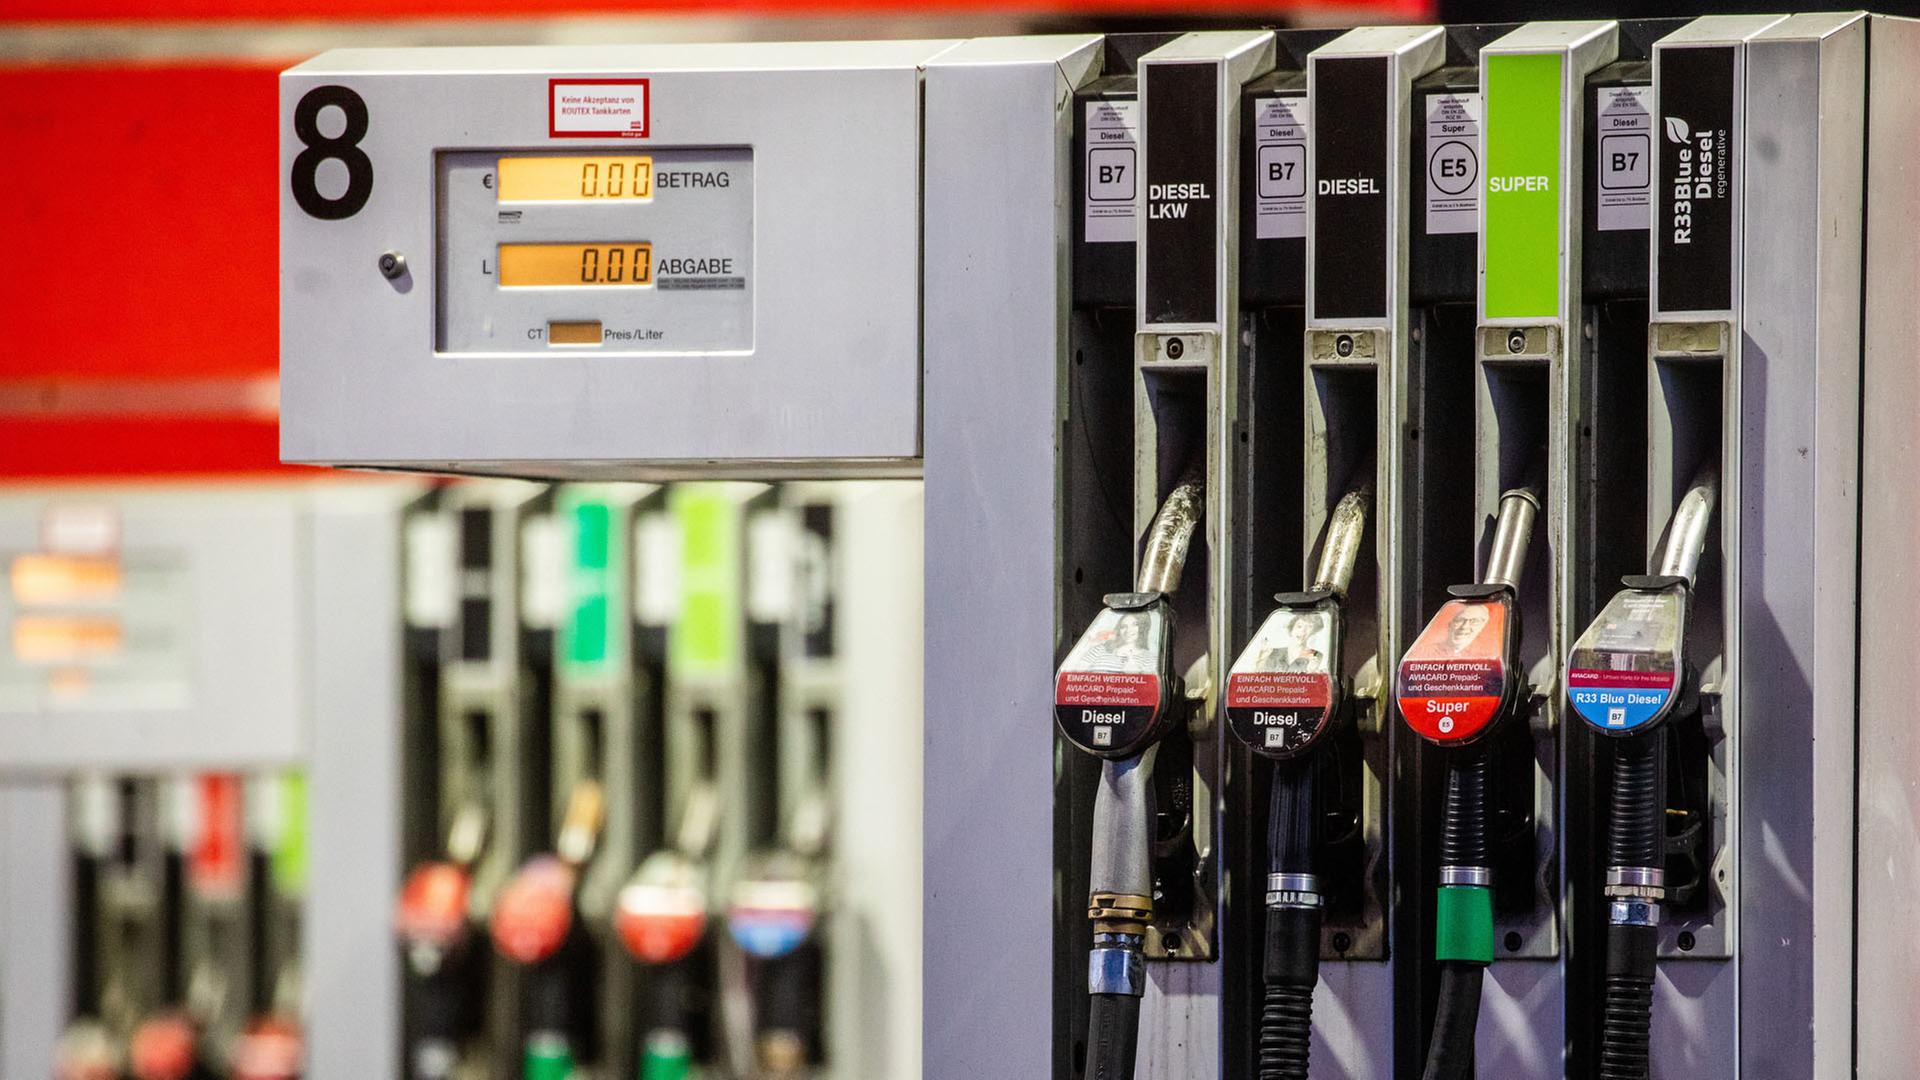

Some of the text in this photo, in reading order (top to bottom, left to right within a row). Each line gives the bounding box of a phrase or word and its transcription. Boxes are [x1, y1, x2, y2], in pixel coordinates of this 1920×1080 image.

[561, 95, 581, 104] Keine
[583, 95, 620, 105] Akzeptanz
[561, 107, 631, 115] ROUTEX Tankkarten
[1441, 125, 1466, 134] Super
[1612, 118, 1639, 128] Diesel
[1100, 131, 1125, 141] Diesel
[1269, 128, 1294, 138] Diesel
[291, 85, 374, 220] 8
[1440, 158, 1468, 178] E5
[1611, 152, 1640, 172] B7
[1695, 130, 1713, 200] Diesel
[1717, 129, 1727, 199] regenerative
[1099, 165, 1126, 184] B7
[1268, 162, 1296, 181] B7
[482, 173, 493, 189] €
[581, 162, 651, 197] 0.00
[657, 172, 730, 189] BETRAG
[1489, 176, 1550, 193] SUPER
[1149, 183, 1211, 200] DIESEL
[1318, 178, 1380, 195] DIESEL
[1149, 203, 1189, 219] LKW
[482, 259, 492, 275] L
[581, 248, 651, 284] 0.00
[657, 258, 733, 275] ABGABE
[527, 328, 543, 340] CT
[1409, 663, 1445, 672] EINFACH
[1066, 674, 1101, 684] EINFACH
[1237, 675, 1271, 684] EINFACH
[1408, 673, 1481, 683] AVIACARD Prepaid-
[1065, 685, 1137, 696] AVIACARD Prepaid-
[1236, 685, 1308, 696] AVIACARD Prepaid-
[1407, 683, 1484, 692] und Geschenkkarten
[1064, 695, 1140, 705] und Geschenkkarten
[1235, 695, 1311, 705] und Geschenkkarten
[1576, 692, 1661, 705] R33 Blue Diesel
[1426, 699, 1470, 715] Super
[1081, 709, 1126, 725] Diesel
[1253, 711, 1297, 726] Diesel
[1611, 712, 1622, 721] B7
[1441, 720, 1451, 728] E5
[1096, 731, 1108, 740] B7
[1269, 733, 1280, 741] B7
